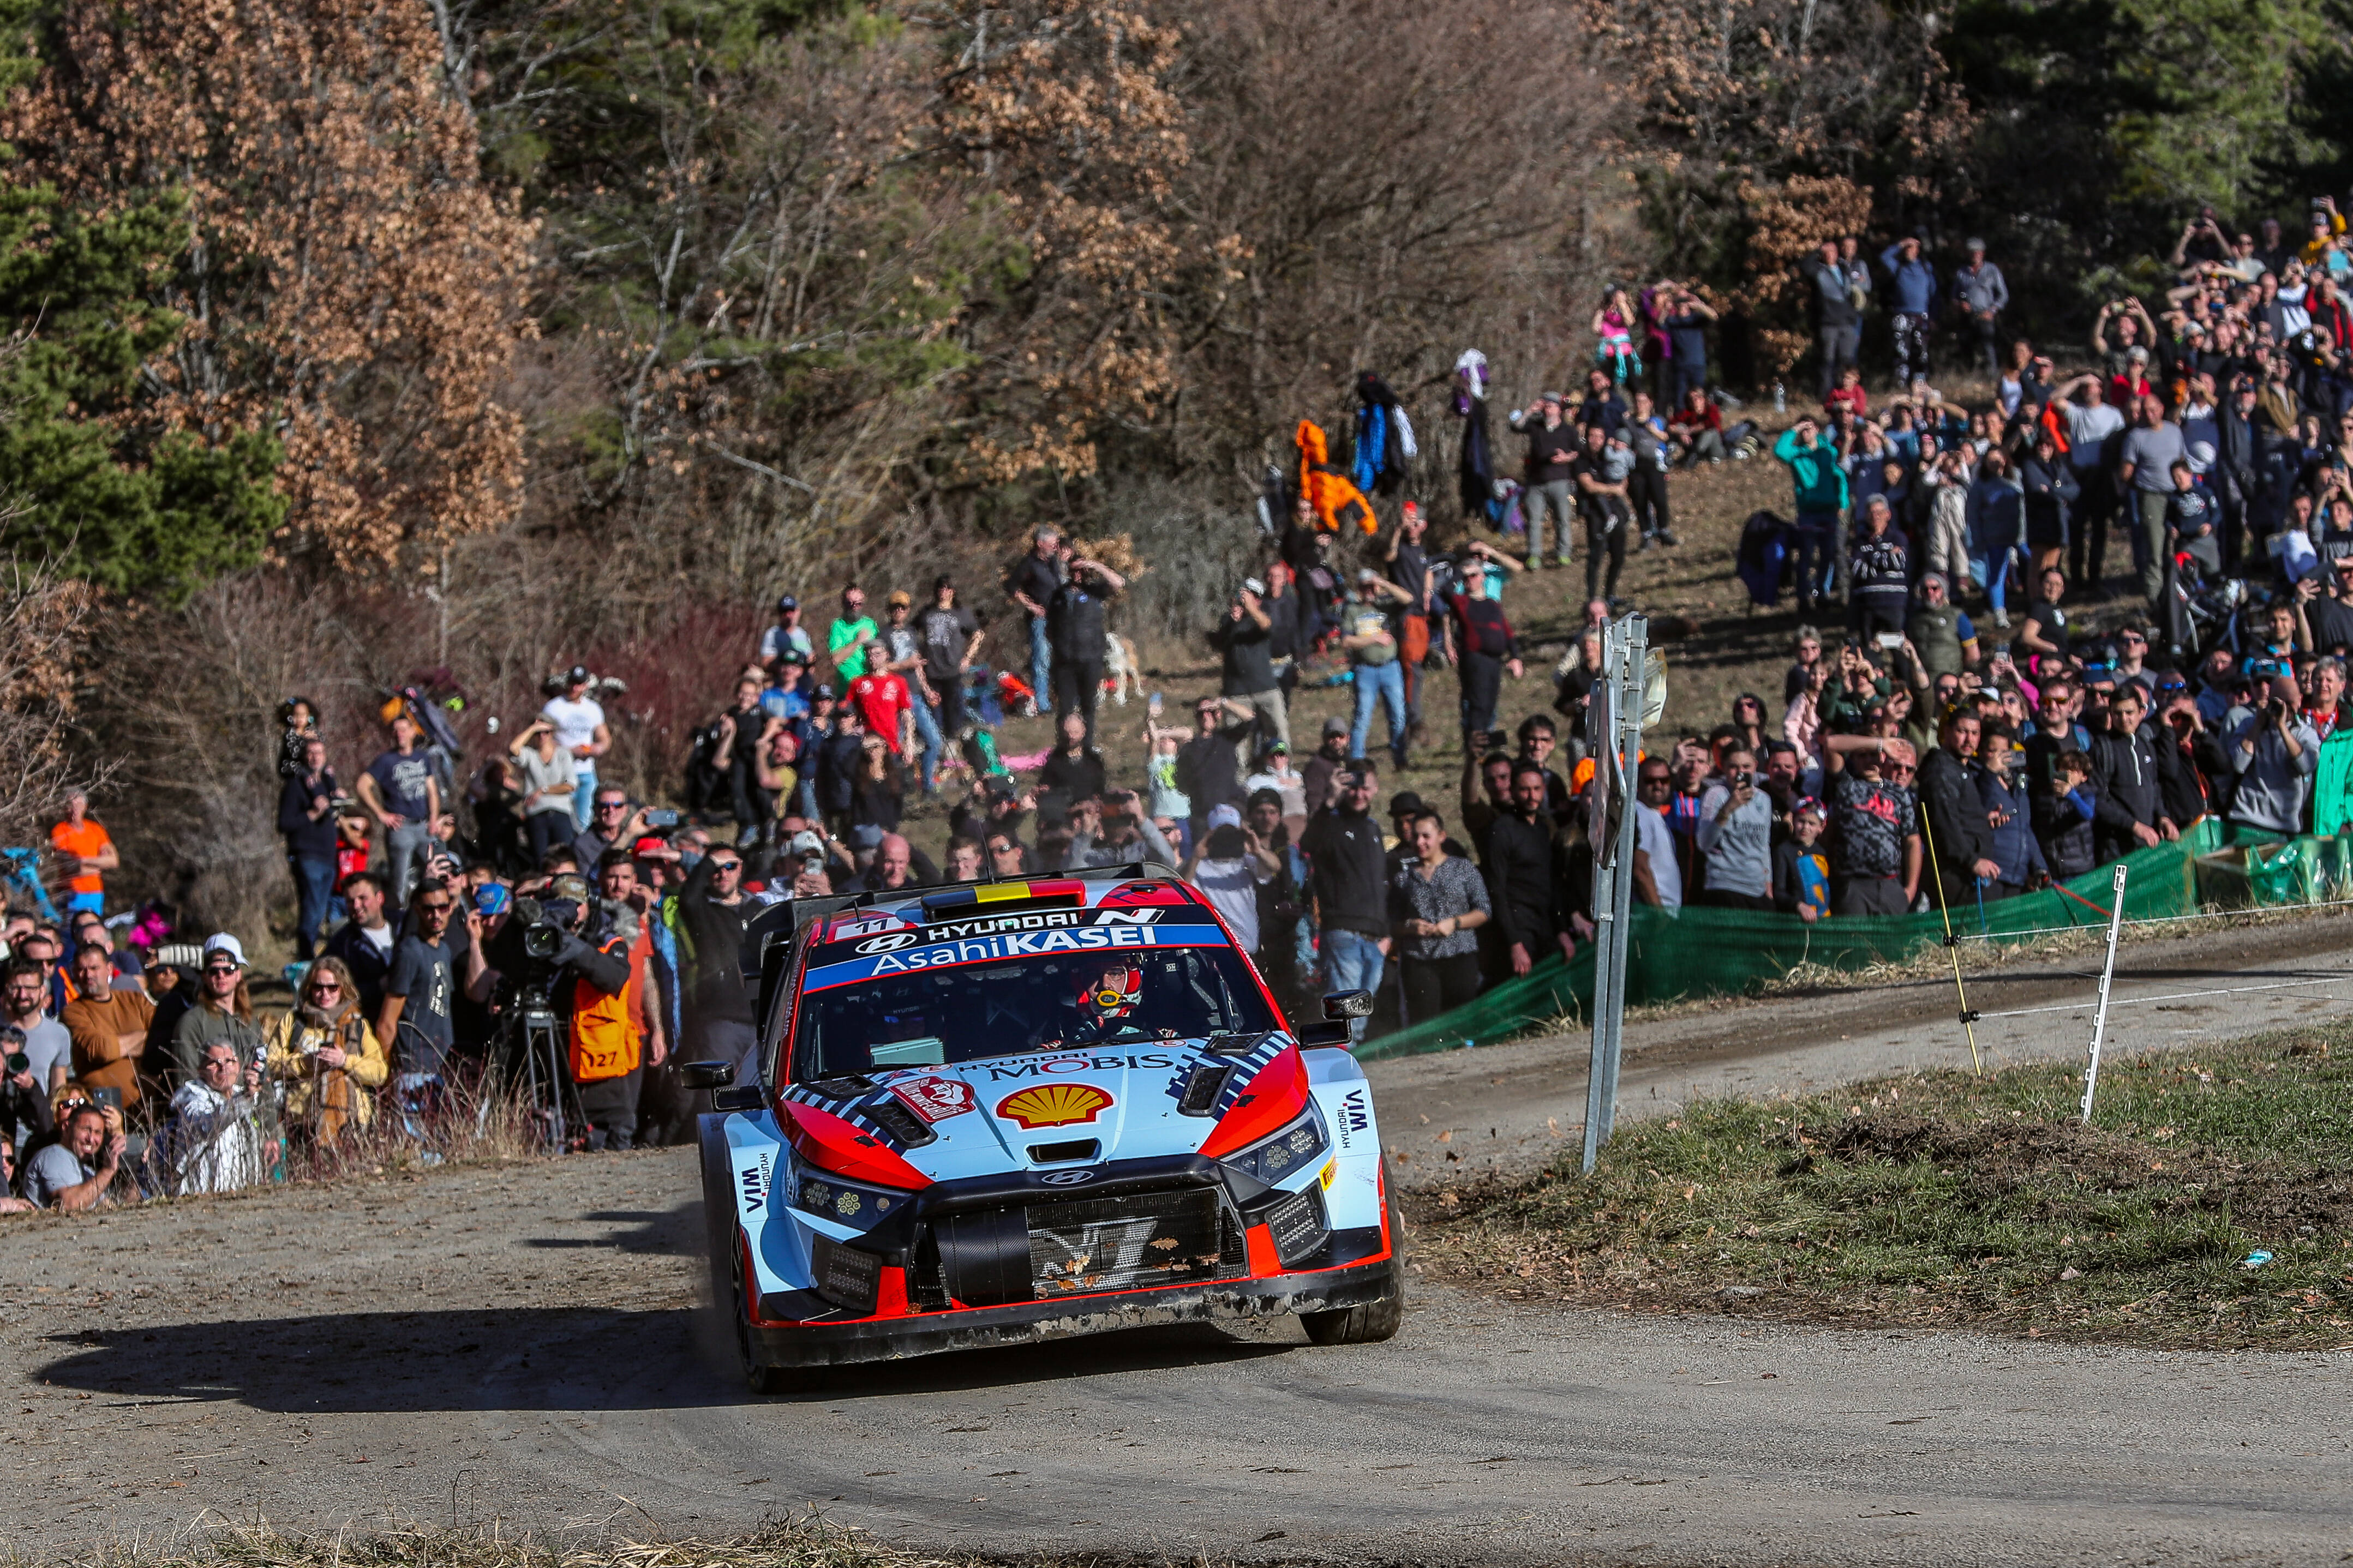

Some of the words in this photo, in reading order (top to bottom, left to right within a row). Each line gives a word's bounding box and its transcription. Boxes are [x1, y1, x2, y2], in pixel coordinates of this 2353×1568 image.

[854, 918, 888, 934] 11
[928, 913, 1078, 941] HYUNDAI
[588, 1052, 617, 1067] 127
[959, 1052, 1088, 1072] HYUNDAI
[987, 1053, 1174, 1082] MOBIS
[1337, 1109, 1351, 1149] HYUNDAI
[759, 1152, 772, 1189] HYUNDAI
